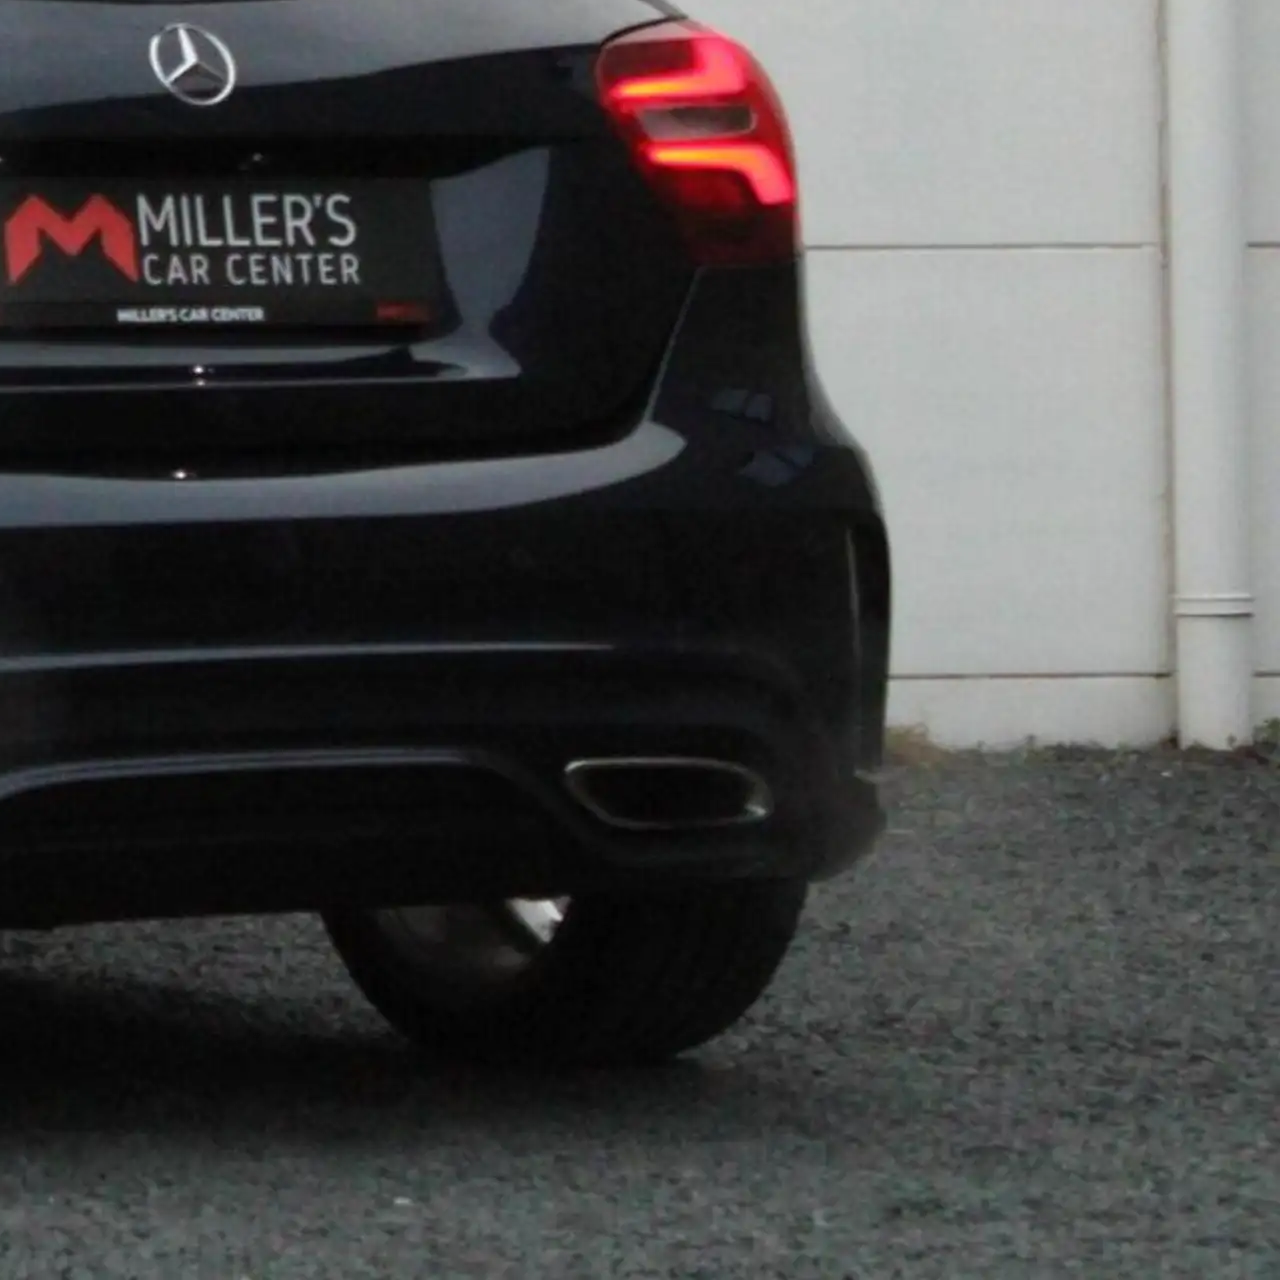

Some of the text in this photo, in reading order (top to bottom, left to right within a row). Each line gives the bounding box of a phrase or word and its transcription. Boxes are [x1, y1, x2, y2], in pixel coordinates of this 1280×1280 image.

[137, 194, 357, 248] MILLER'S
[143, 253, 359, 285] CAR CENTER
[179, 307, 209, 322] CAR
